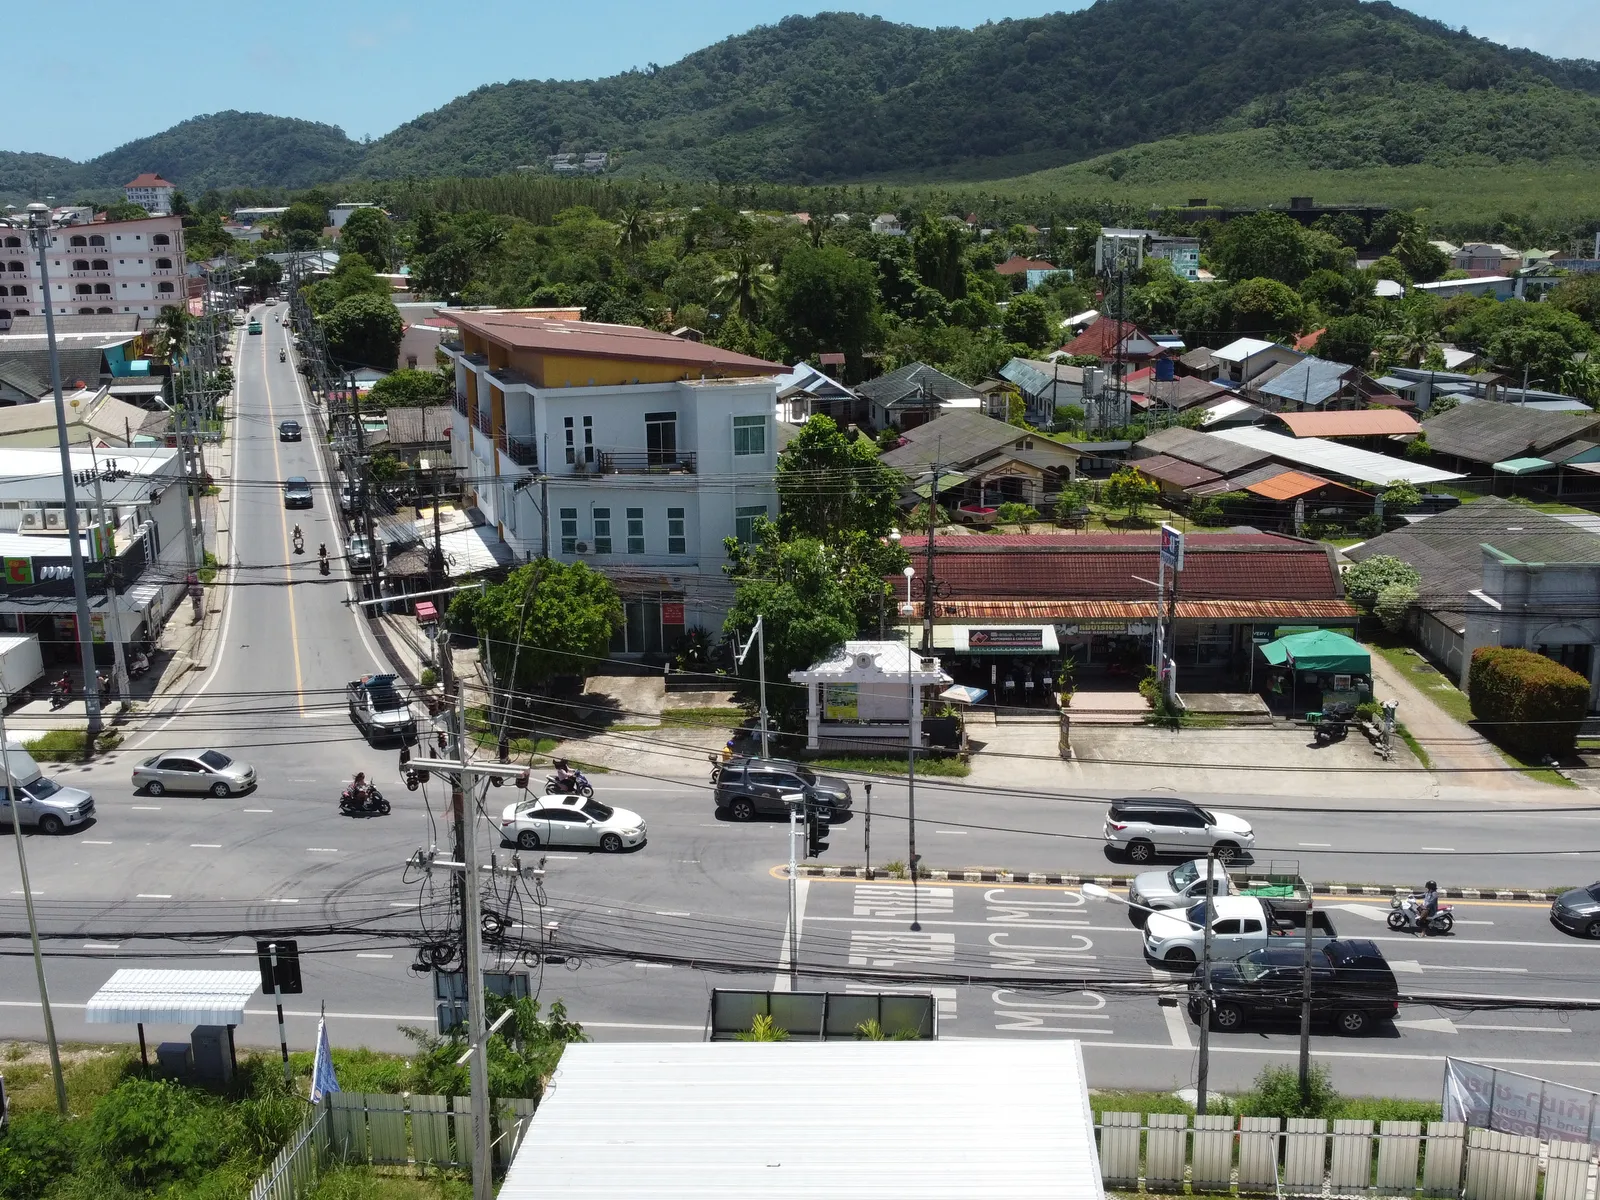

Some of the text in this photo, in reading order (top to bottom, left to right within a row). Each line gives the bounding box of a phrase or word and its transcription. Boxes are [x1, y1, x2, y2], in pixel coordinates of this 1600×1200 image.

[984, 889, 1090, 925] MC
[988, 932, 1100, 972] MC
[992, 989, 1114, 1034] MC
